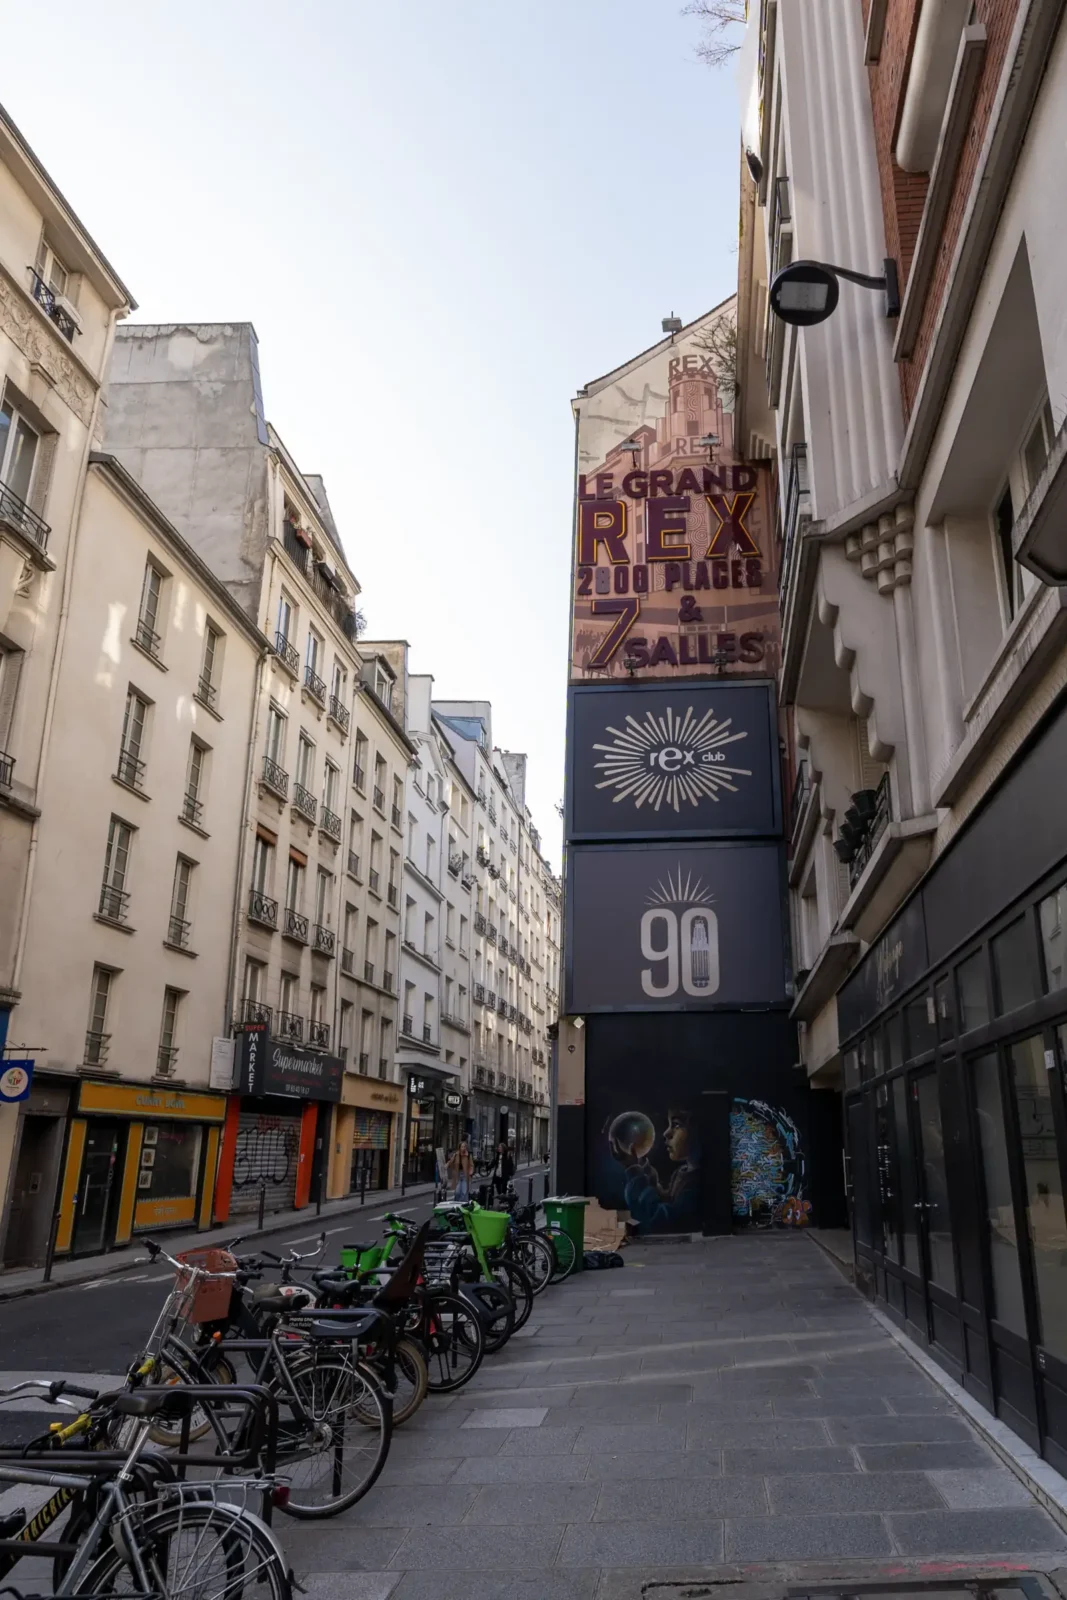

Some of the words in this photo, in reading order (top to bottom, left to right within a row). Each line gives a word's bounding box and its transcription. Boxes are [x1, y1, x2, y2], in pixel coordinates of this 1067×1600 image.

[668, 354, 716, 379] REX
[578, 474, 613, 499] LE
[622, 465, 757, 499] GRAND
[578, 493, 762, 566] REX
[578, 565, 648, 595] 2800
[665, 560, 762, 592] PLACES
[678, 595, 702, 622] &
[587, 598, 640, 668] 7
[624, 632, 764, 669] SALLES
[650, 747, 695, 772] rex
[702, 751, 726, 762] club
[641, 907, 720, 998] 90
[248, 1032, 259, 1093] MARKET
[272, 1047, 323, 1076] Supermarket
